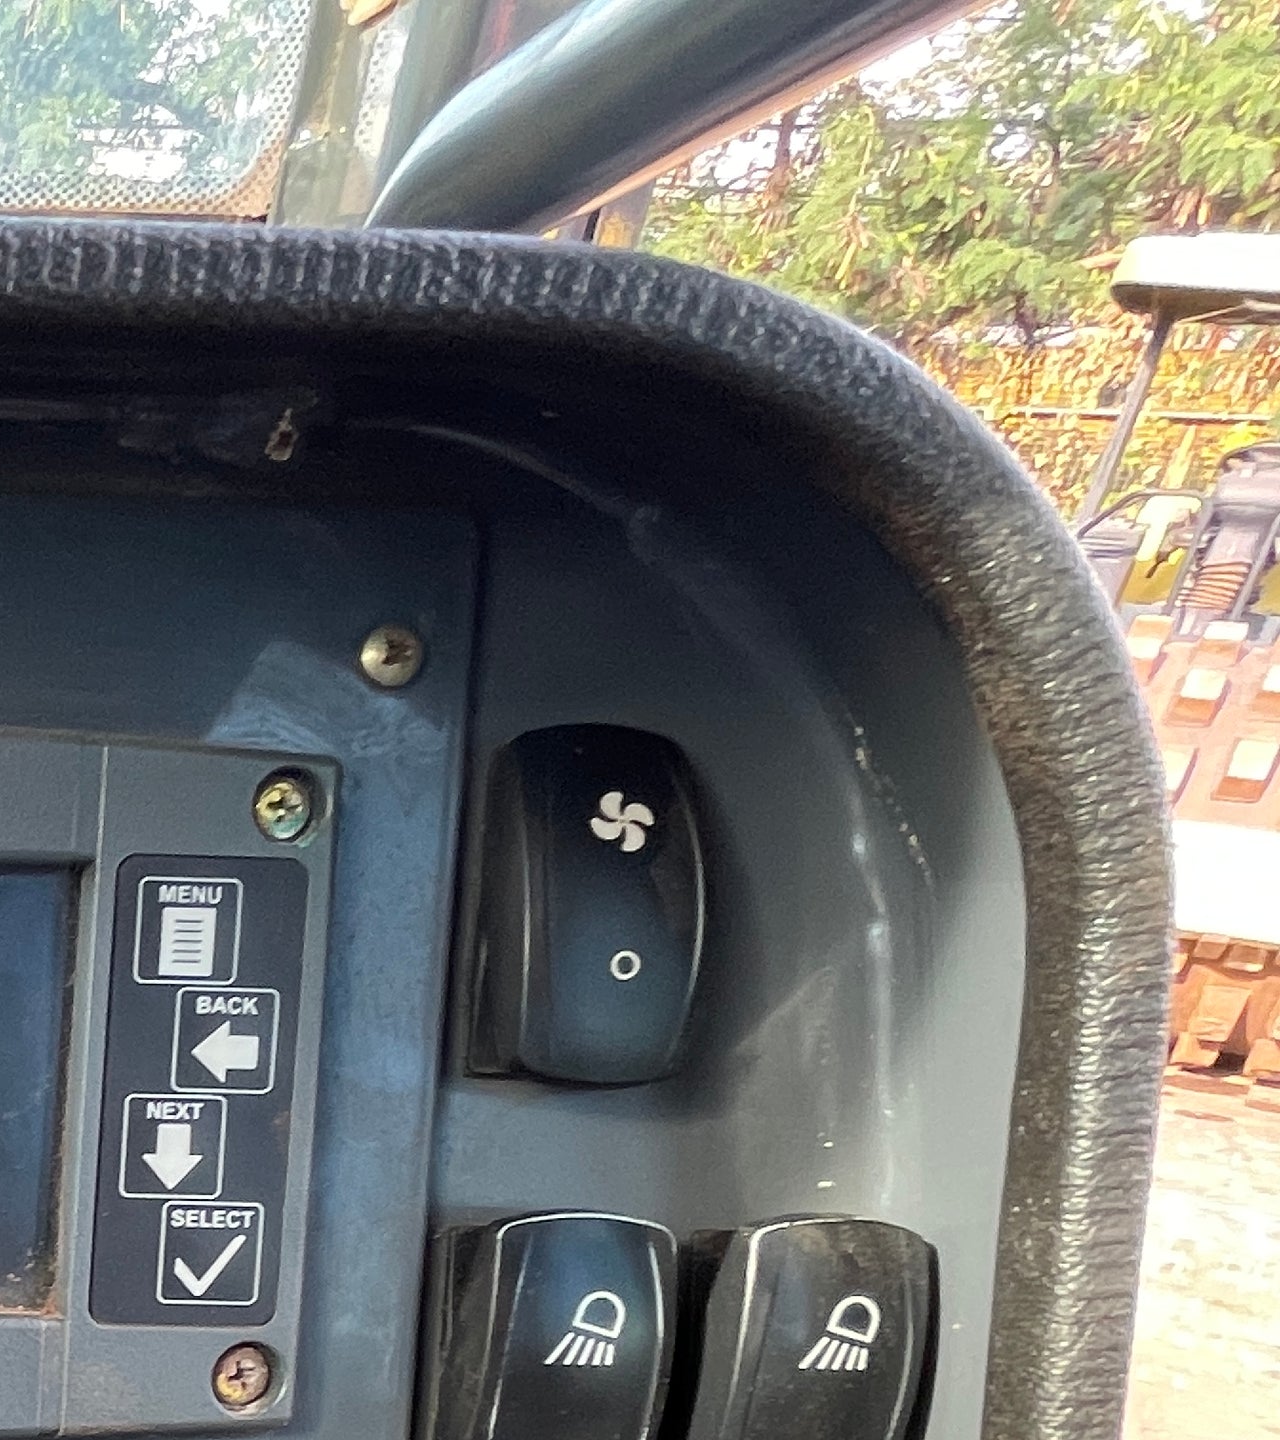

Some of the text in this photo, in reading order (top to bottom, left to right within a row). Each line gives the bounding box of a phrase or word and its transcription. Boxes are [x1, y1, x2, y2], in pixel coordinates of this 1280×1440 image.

[158, 884, 223, 905] MENU
[195, 995, 259, 1015] BACK
[146, 1101, 205, 1120] NEXT
[170, 1208, 256, 1229] SELECT
